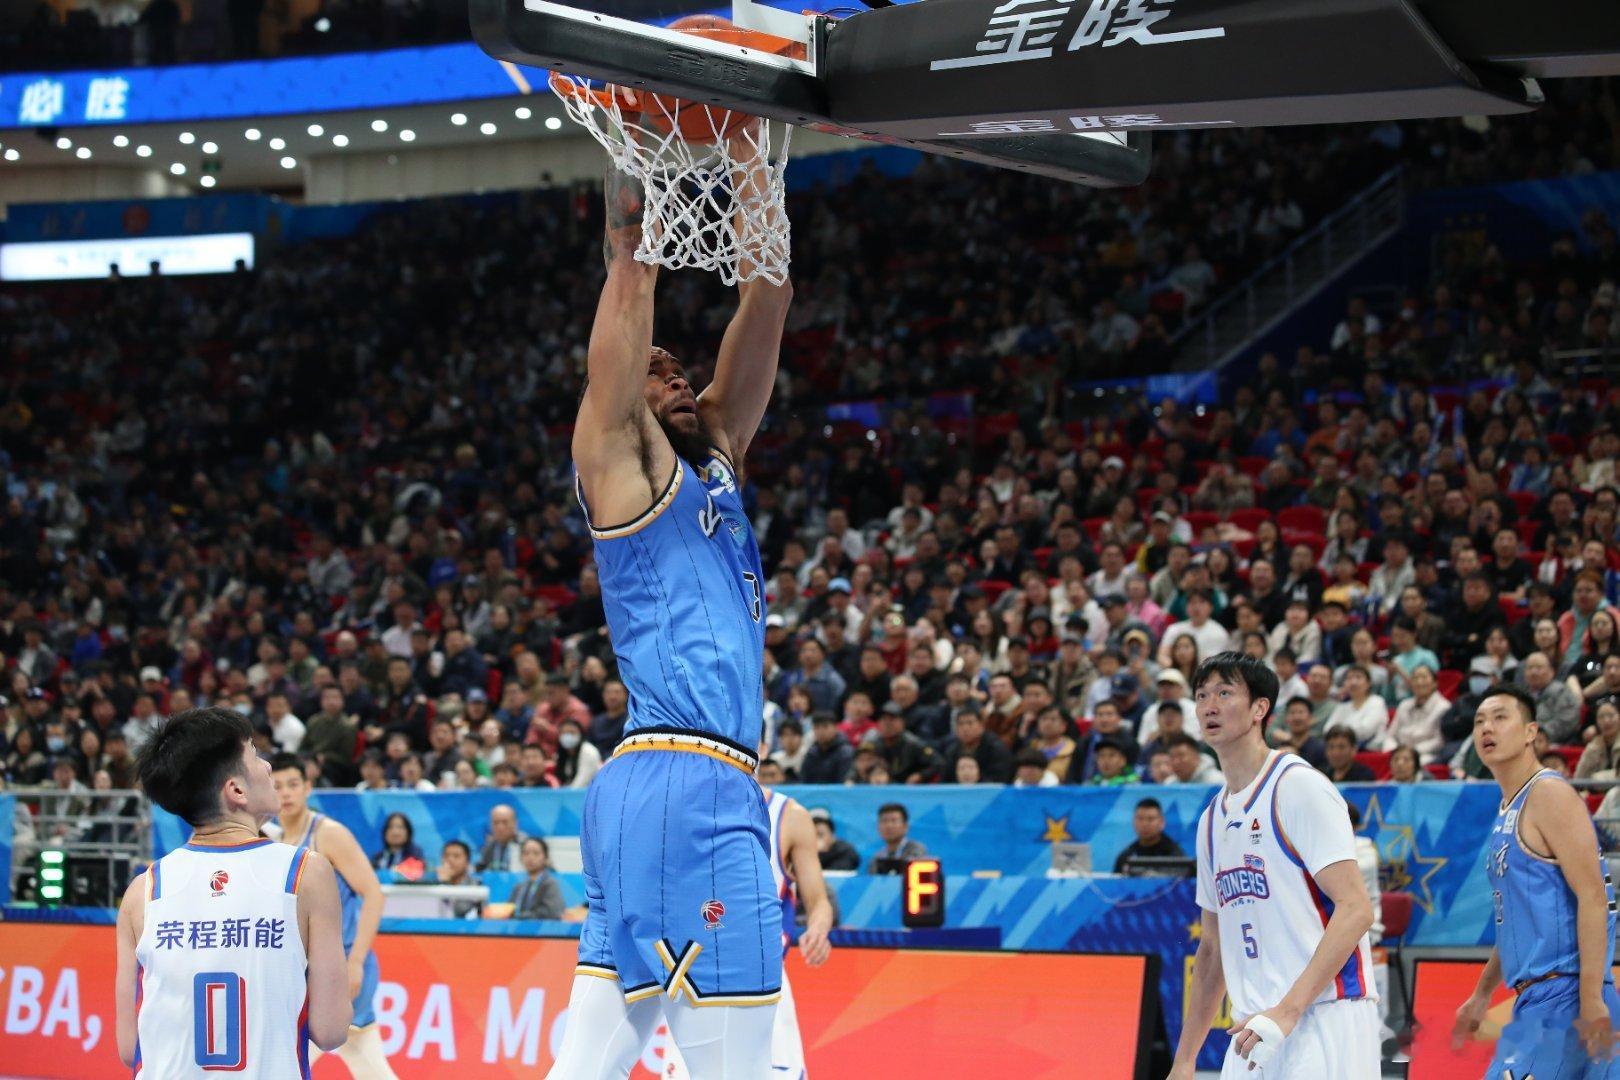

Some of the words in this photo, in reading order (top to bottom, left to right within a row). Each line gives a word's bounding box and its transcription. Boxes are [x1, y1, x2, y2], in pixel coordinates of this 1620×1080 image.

[908, 861, 939, 915] F
[155, 917, 285, 950] 荣程新能
[1241, 923, 1259, 959] 5
[0, 965, 103, 1052] BA,
[193, 971, 247, 1072] 0
[372, 981, 457, 1062] BA
